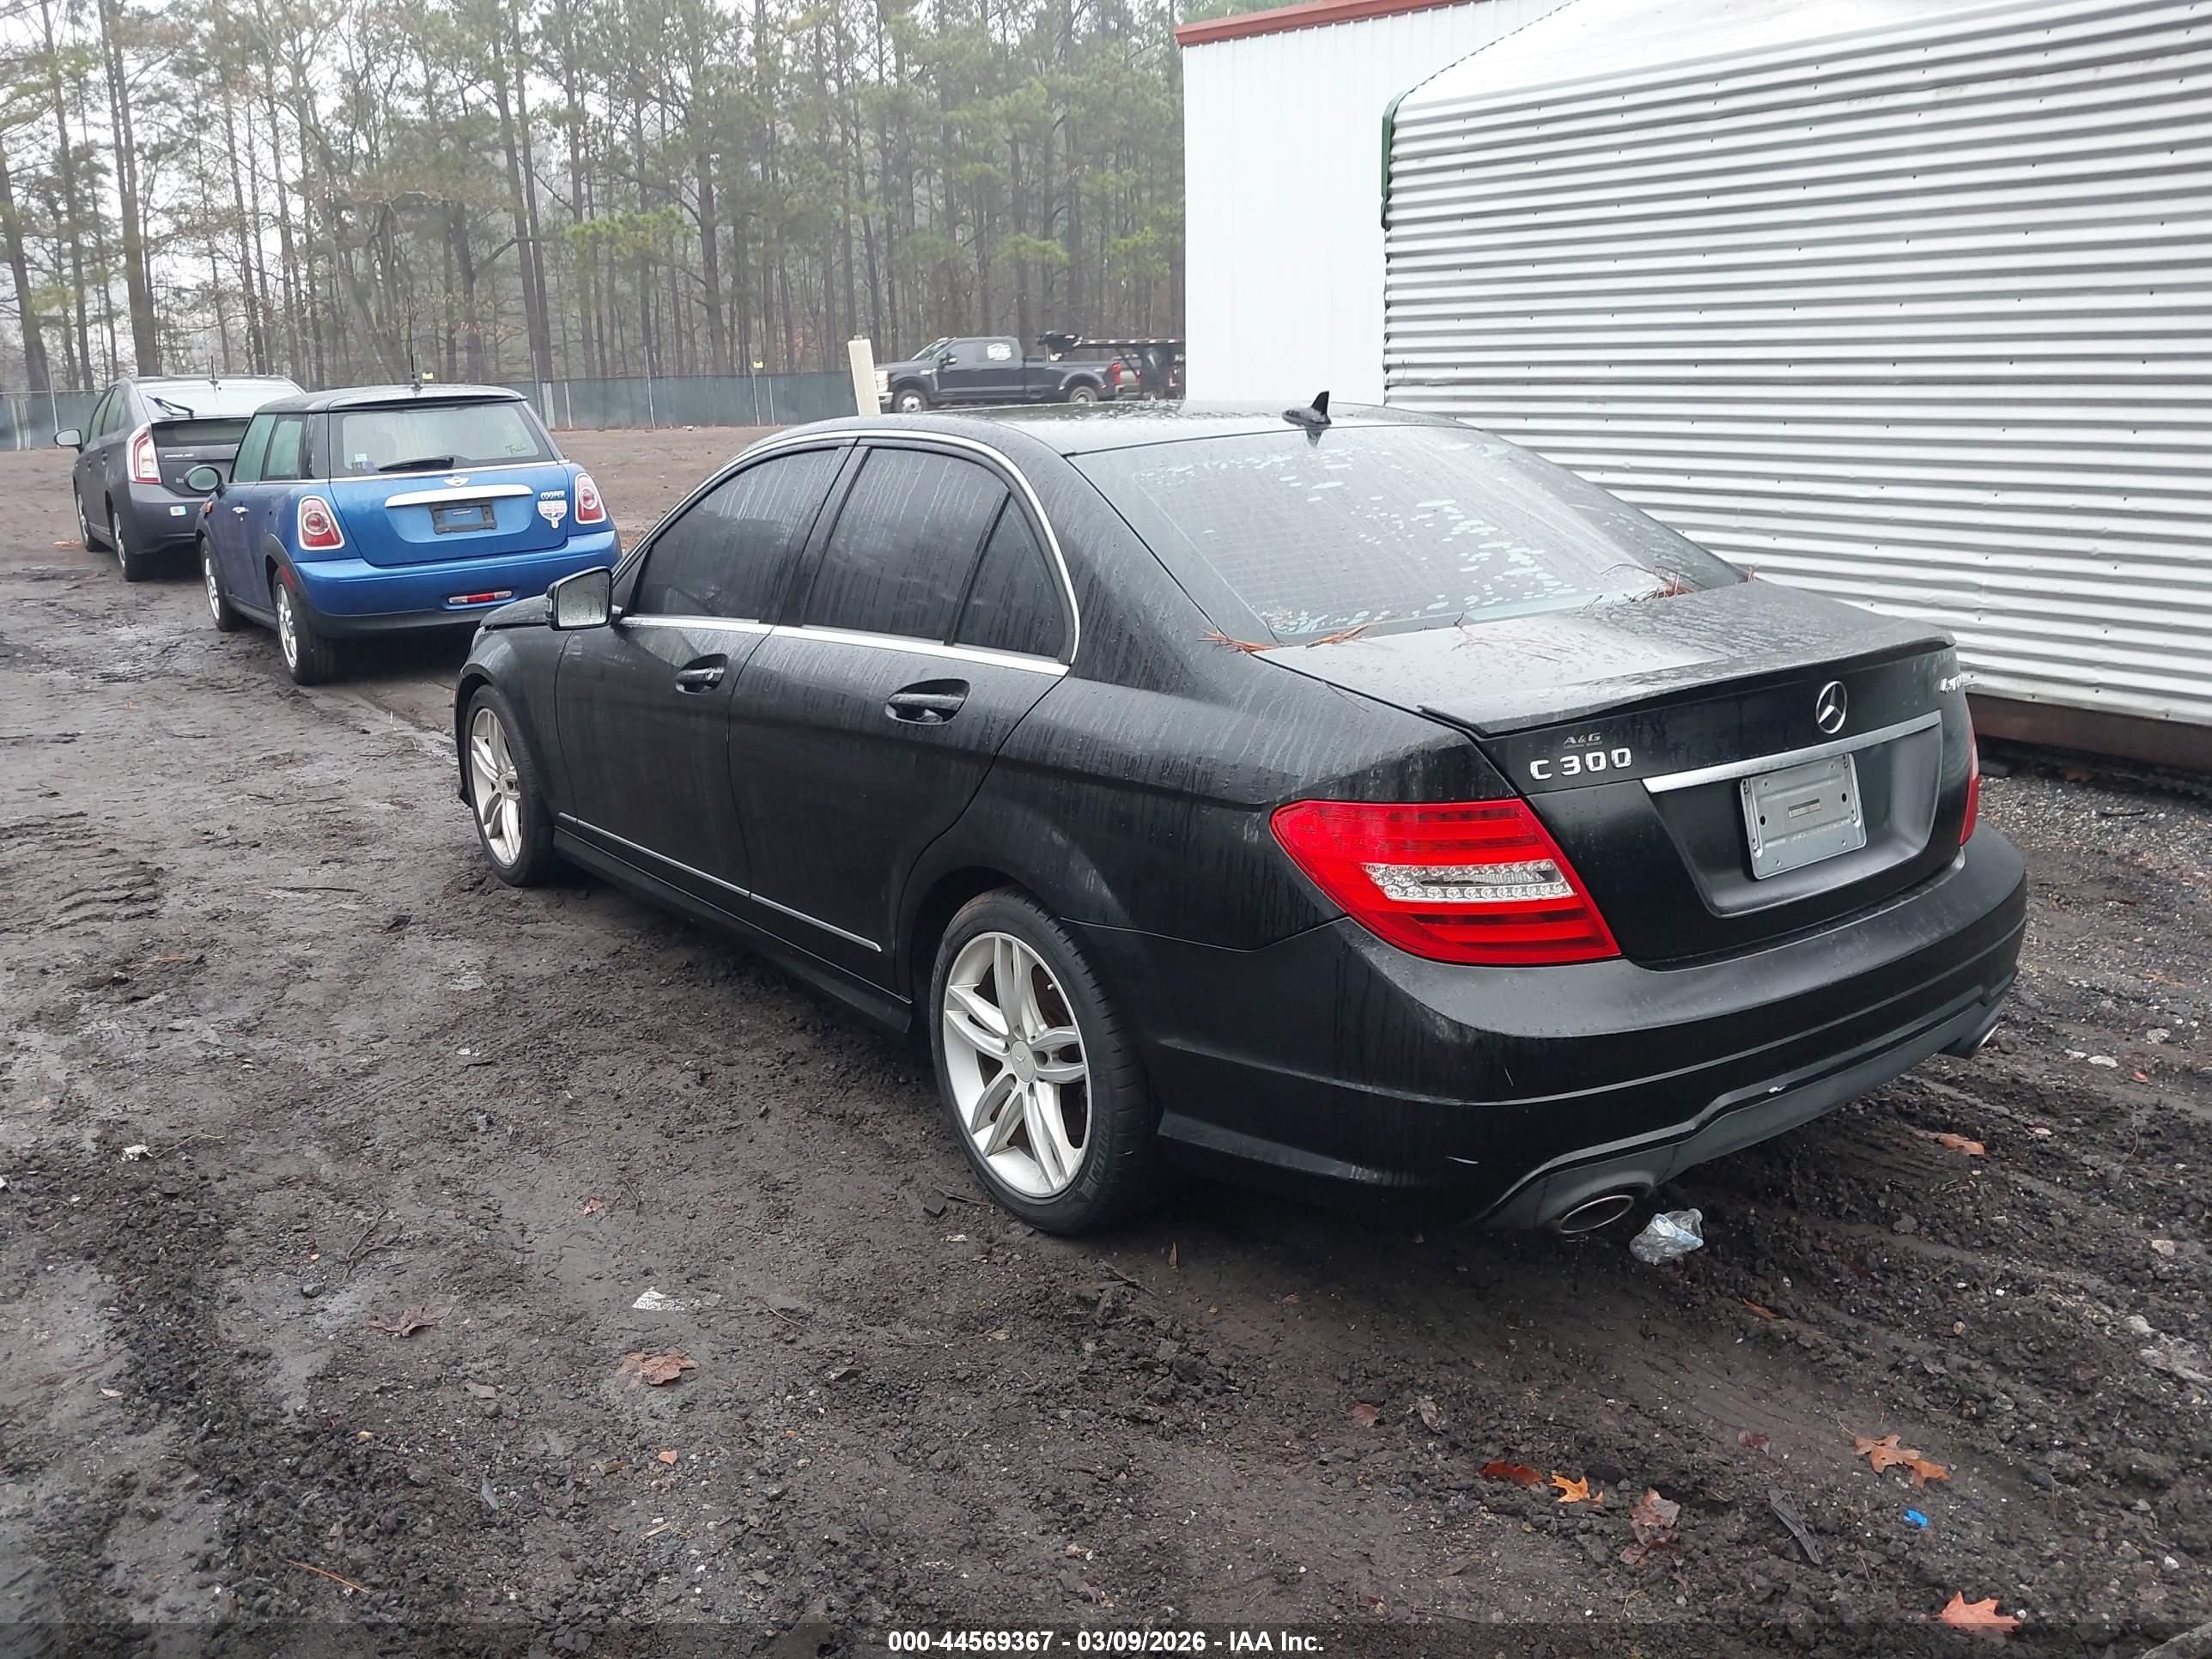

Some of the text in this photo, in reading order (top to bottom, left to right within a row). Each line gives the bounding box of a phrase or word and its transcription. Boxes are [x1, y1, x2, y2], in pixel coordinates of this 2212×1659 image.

[540, 490, 565, 500] COOPER
[1529, 747, 1632, 780] C 300
